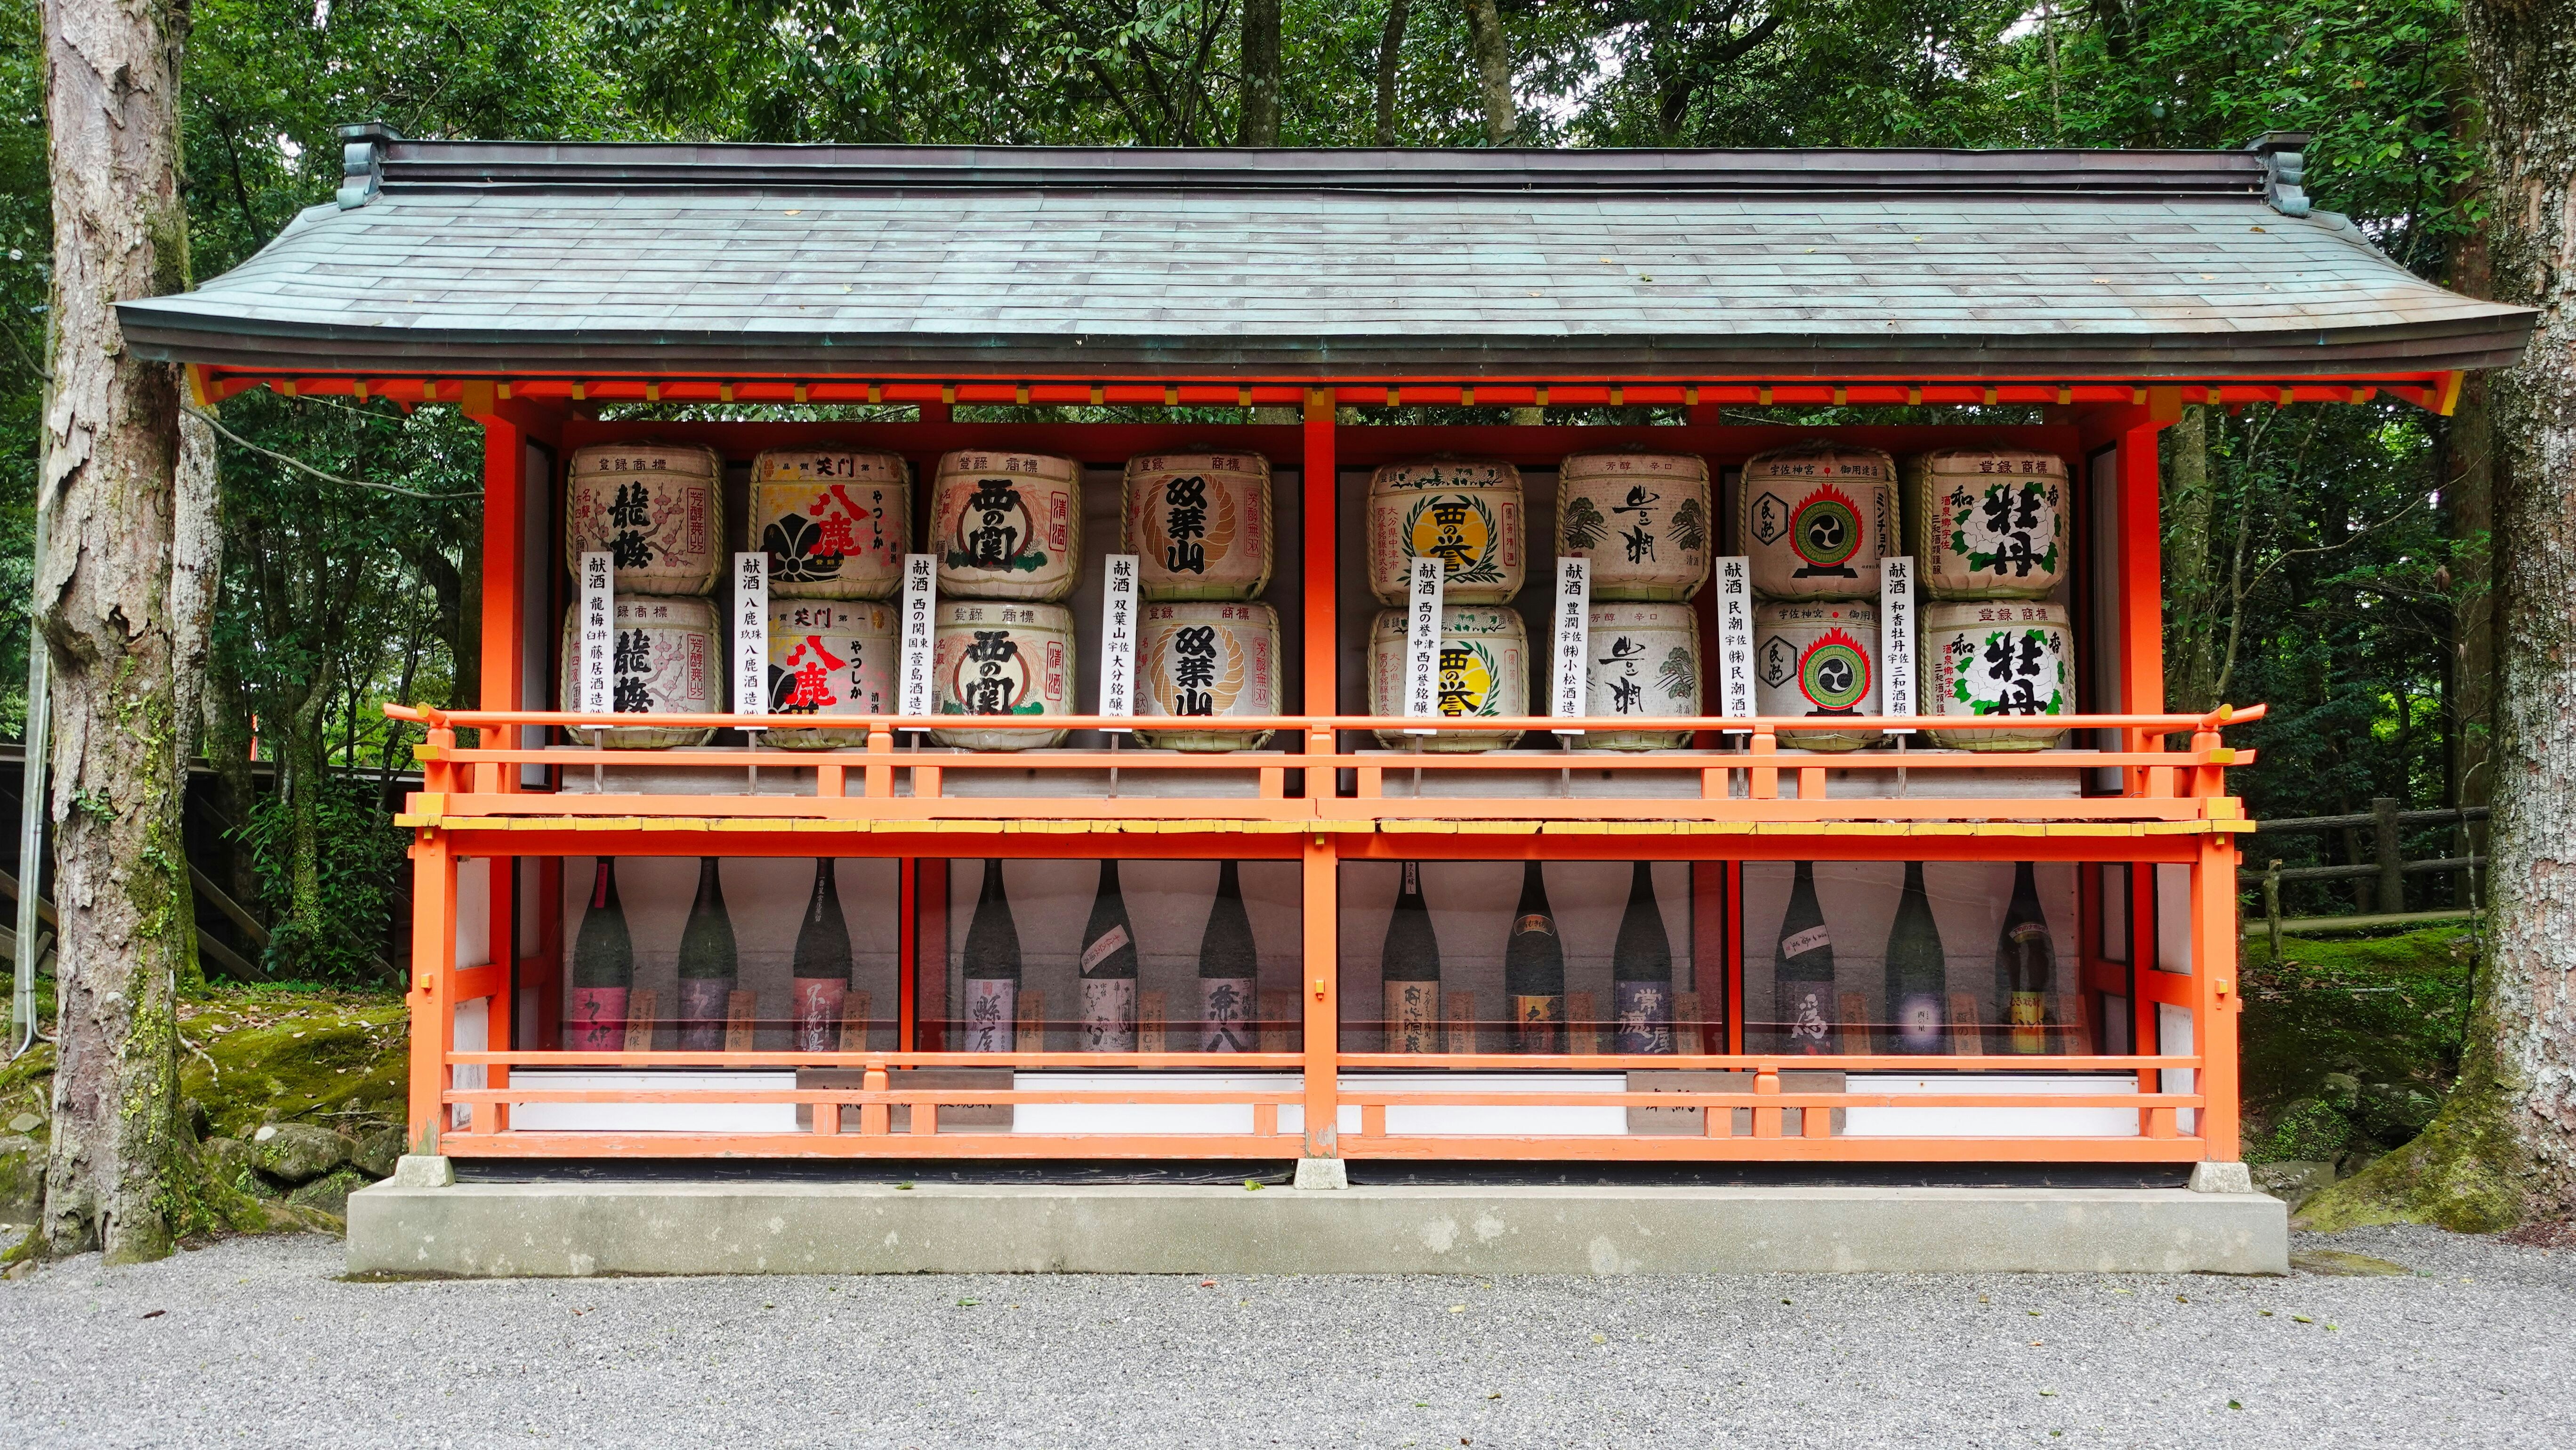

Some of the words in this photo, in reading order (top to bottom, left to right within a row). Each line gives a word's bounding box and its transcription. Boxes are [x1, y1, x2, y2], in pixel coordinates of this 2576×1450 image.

[816, 457, 854, 478] 笑門
[1212, 456, 1240, 471] 商標
[1606, 462, 1631, 470] 芳醇
[1770, 465, 1815, 475] 宇佐神宮
[1979, 460, 2012, 474] 登録
[2021, 460, 2048, 474] 商標
[808, 484, 870, 556] 八鹿
[872, 490, 884, 550] やつしか
[969, 479, 1021, 573] 西の関
[1052, 497, 1067, 546] 清酒
[1166, 476, 1208, 575] 双葉山
[1940, 496, 1951, 550] 酒泉郷宇佐
[1979, 481, 2045, 577] 牡丹
[1387, 506, 1399, 571] 大分県中津市
[1430, 503, 1477, 572] 西の誉
[589, 557, 606, 589] 献酒
[742, 558, 761, 591] 献酒
[912, 560, 930, 593] 献酒
[1113, 561, 1132, 593] 献酒
[1418, 563, 1437, 596] 献酒
[1565, 563, 1582, 596] 献酒
[1724, 563, 1742, 594] 献酒
[1889, 563, 1908, 595] 献酒
[590, 596, 604, 627] 龍梅
[744, 597, 759, 626] 八鹿
[794, 607, 832, 628] 笑門
[912, 598, 926, 636] 西の関
[1112, 599, 1128, 639] 双葉山
[1149, 606, 1174, 620] 登録
[1222, 607, 1250, 620] 商標
[1418, 602, 1432, 637] 西の誉
[1564, 602, 1579, 629] 豊潤
[1591, 613, 1615, 622] 芳醇
[1634, 613, 1657, 621] 辛口
[1728, 601, 1742, 630] 民潮
[1779, 610, 1823, 620] 宇佐神宮
[1890, 601, 1906, 652] 和香牡丹
[1979, 608, 2012, 622] 登録
[2022, 608, 2048, 621] 商標
[587, 630, 607, 641] 臼杵
[741, 628, 762, 640] 玖珠
[909, 637, 928, 649] 国東
[1108, 641, 1129, 653] 宇佐
[1414, 639, 1434, 650] 中津
[1561, 631, 1582, 642] 宇佐
[1725, 635, 1747, 645] 宇佐
[785, 636, 846, 707] 八鹿
[850, 641, 862, 699] やつしか
[1048, 647, 1062, 695] 清酒
[1175, 626, 1216, 716] 双葉山
[1888, 653, 1909, 664] 宇佐
[1942, 644, 1954, 699] 酒泉郷宇佐
[1983, 628, 2048, 716] 牡丹
[1109, 655, 1125, 717] 大分銘醸
[1414, 652, 1430, 717] 西の誉銘醸
[1562, 644, 1578, 717] (株)小松酒造
[1892, 666, 1907, 717] 三和酒類
[1935, 663, 1946, 716] 三和酒類謹
[871, 692, 879, 714] 清酒
